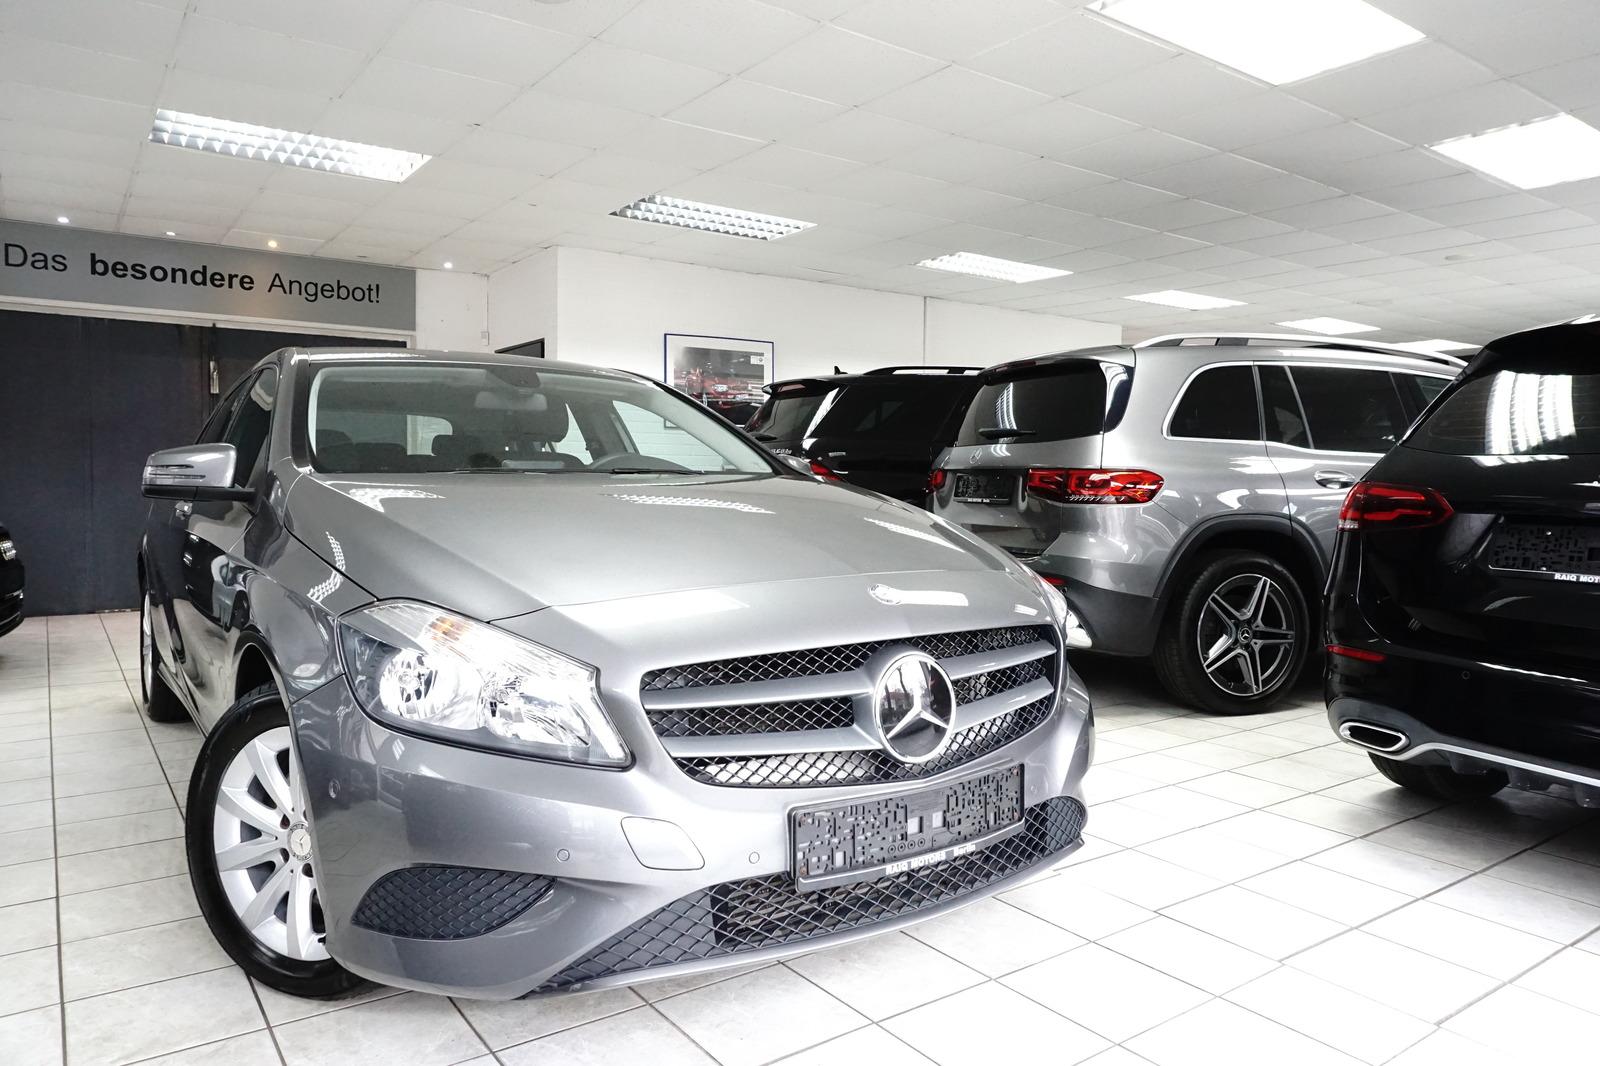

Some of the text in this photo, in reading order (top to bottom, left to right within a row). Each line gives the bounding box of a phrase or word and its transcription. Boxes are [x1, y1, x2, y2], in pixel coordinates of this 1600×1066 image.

[3, 242, 381, 304] Das besondere Angebot!
[1554, 573, 1600, 584] RAIQ MOT
[911, 850, 946, 869] MOTORS
